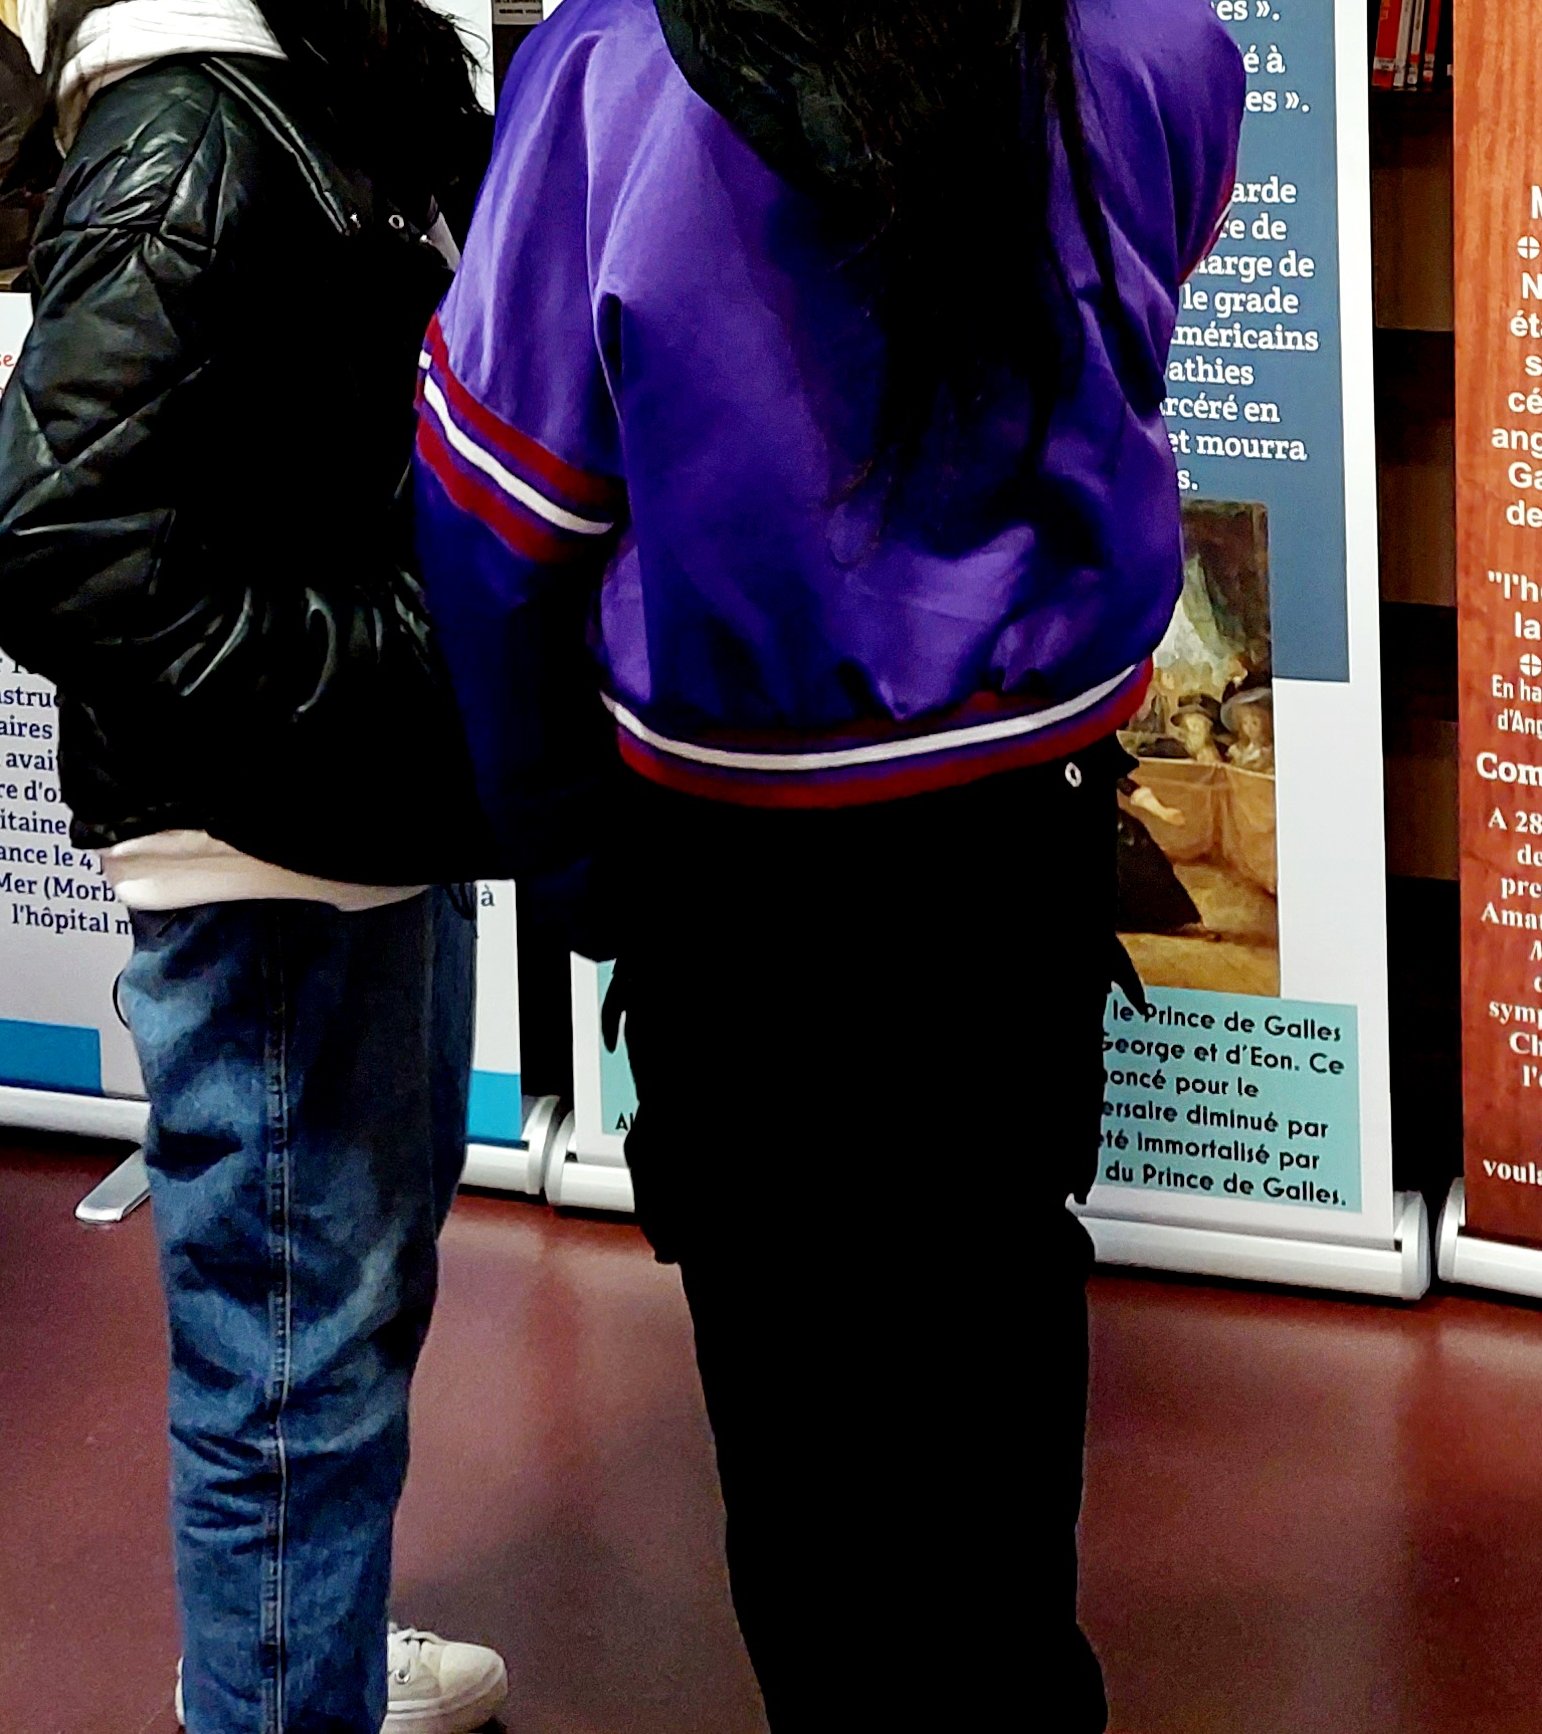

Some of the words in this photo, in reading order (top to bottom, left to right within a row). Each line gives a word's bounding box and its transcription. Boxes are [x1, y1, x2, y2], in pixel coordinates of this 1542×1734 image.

[1183, 283, 1207, 310] le
[1215, 286, 1298, 318] grade
[1489, 808, 1506, 829] A
[1516, 811, 1542, 834] 28
[54, 845, 73, 866] le
[80, 853, 93, 871] 4
[1224, 1011, 1254, 1033] de
[1265, 1016, 1340, 1041] Galles
[1194, 1043, 1217, 1062] et
[1226, 1043, 1300, 1072] d'Eon.
[1310, 1053, 1344, 1074] Ce
[1288, 1120, 1328, 1139] par
[1280, 1152, 1319, 1170] par
[1105, 1161, 1133, 1183] du
[1143, 1164, 1214, 1191] Prince
[1224, 1172, 1254, 1195] de
[1263, 1177, 1346, 1205] Galles.
